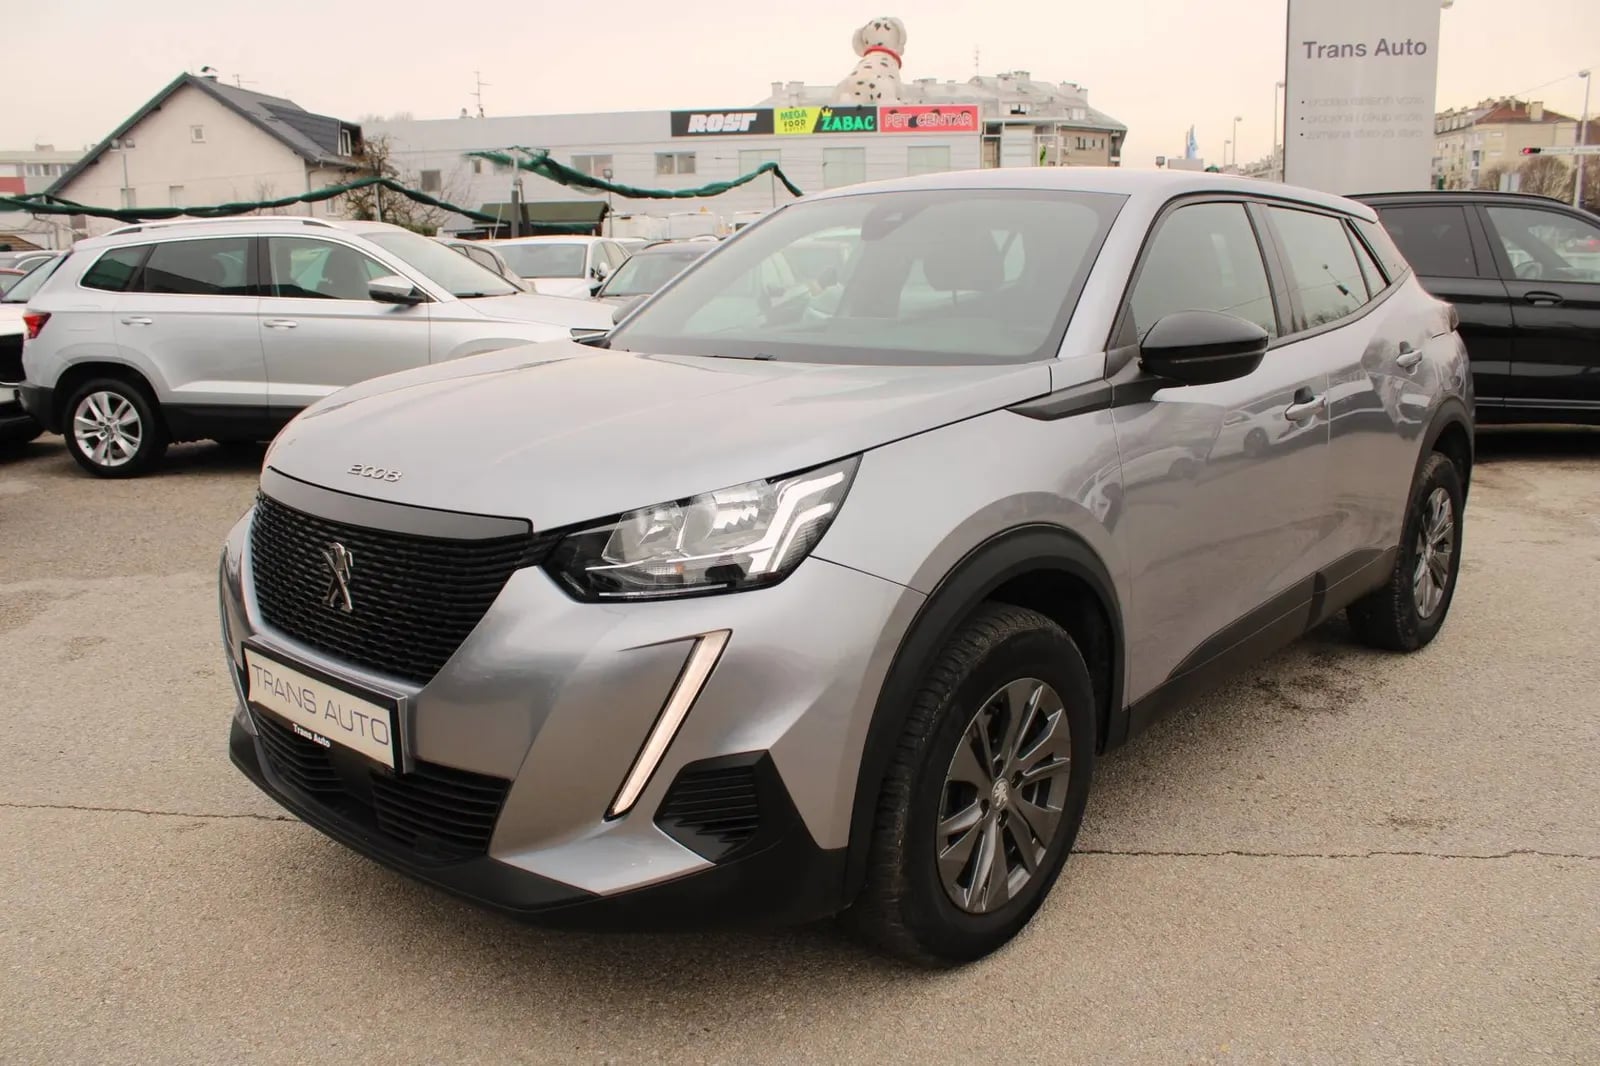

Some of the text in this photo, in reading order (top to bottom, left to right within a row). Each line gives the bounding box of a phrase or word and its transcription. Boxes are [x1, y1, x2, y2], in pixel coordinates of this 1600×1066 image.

[1302, 38, 1427, 59] Trans Auto
[687, 112, 758, 133] ROST
[780, 109, 807, 120] MEGA
[783, 119, 806, 128] FOOD
[884, 112, 973, 128] PET CENTAR
[251, 663, 390, 746] TRANS AUTO
[292, 723, 331, 748] Trans Auto
